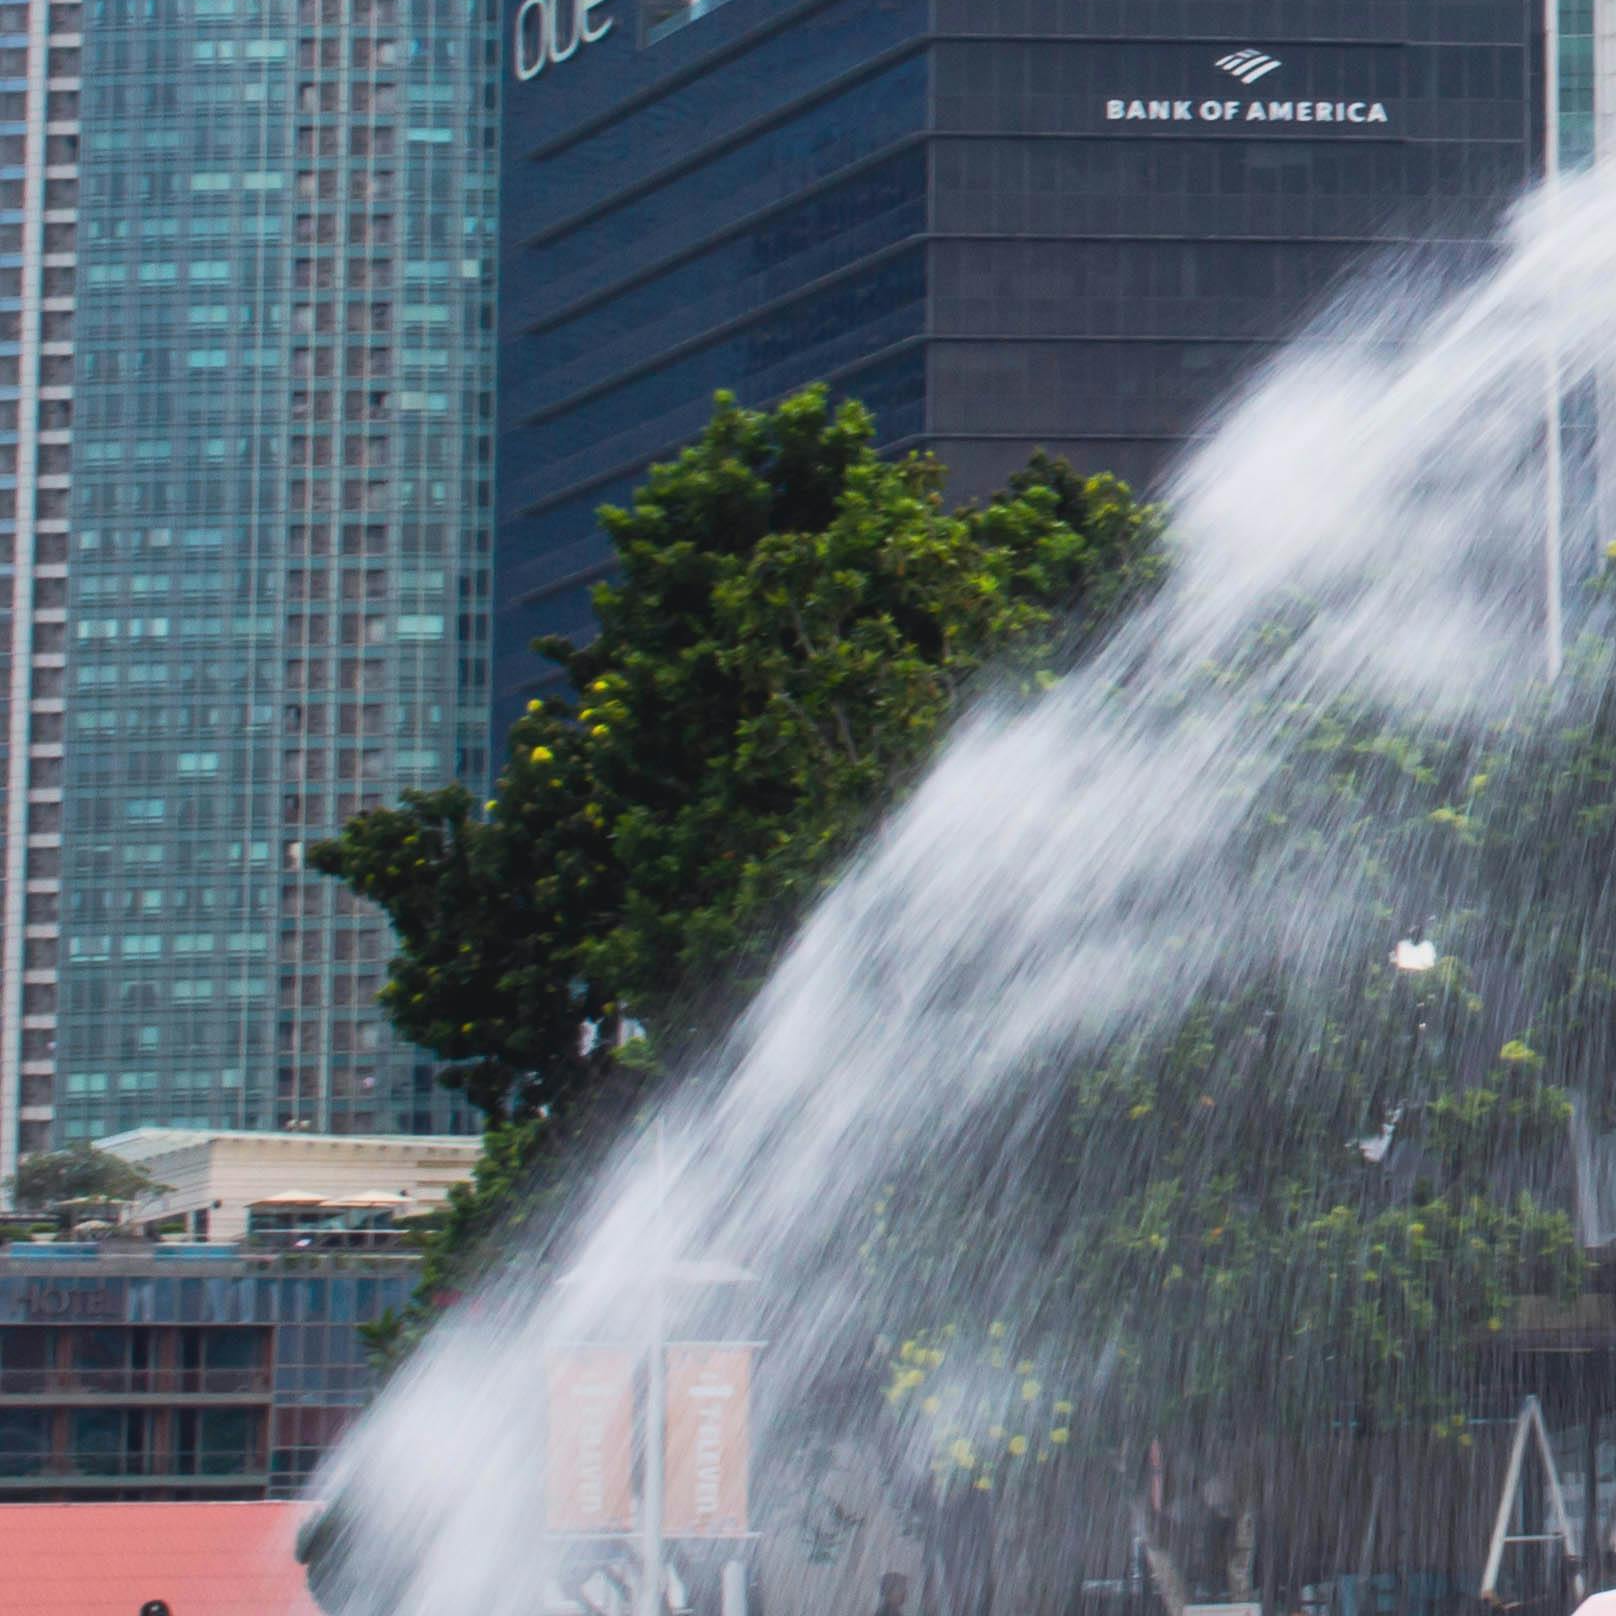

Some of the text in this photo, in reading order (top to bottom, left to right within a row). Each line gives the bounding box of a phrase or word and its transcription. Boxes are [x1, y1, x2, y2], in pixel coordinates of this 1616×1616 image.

[1105, 99, 1389, 123] BANK OF AMERICA
